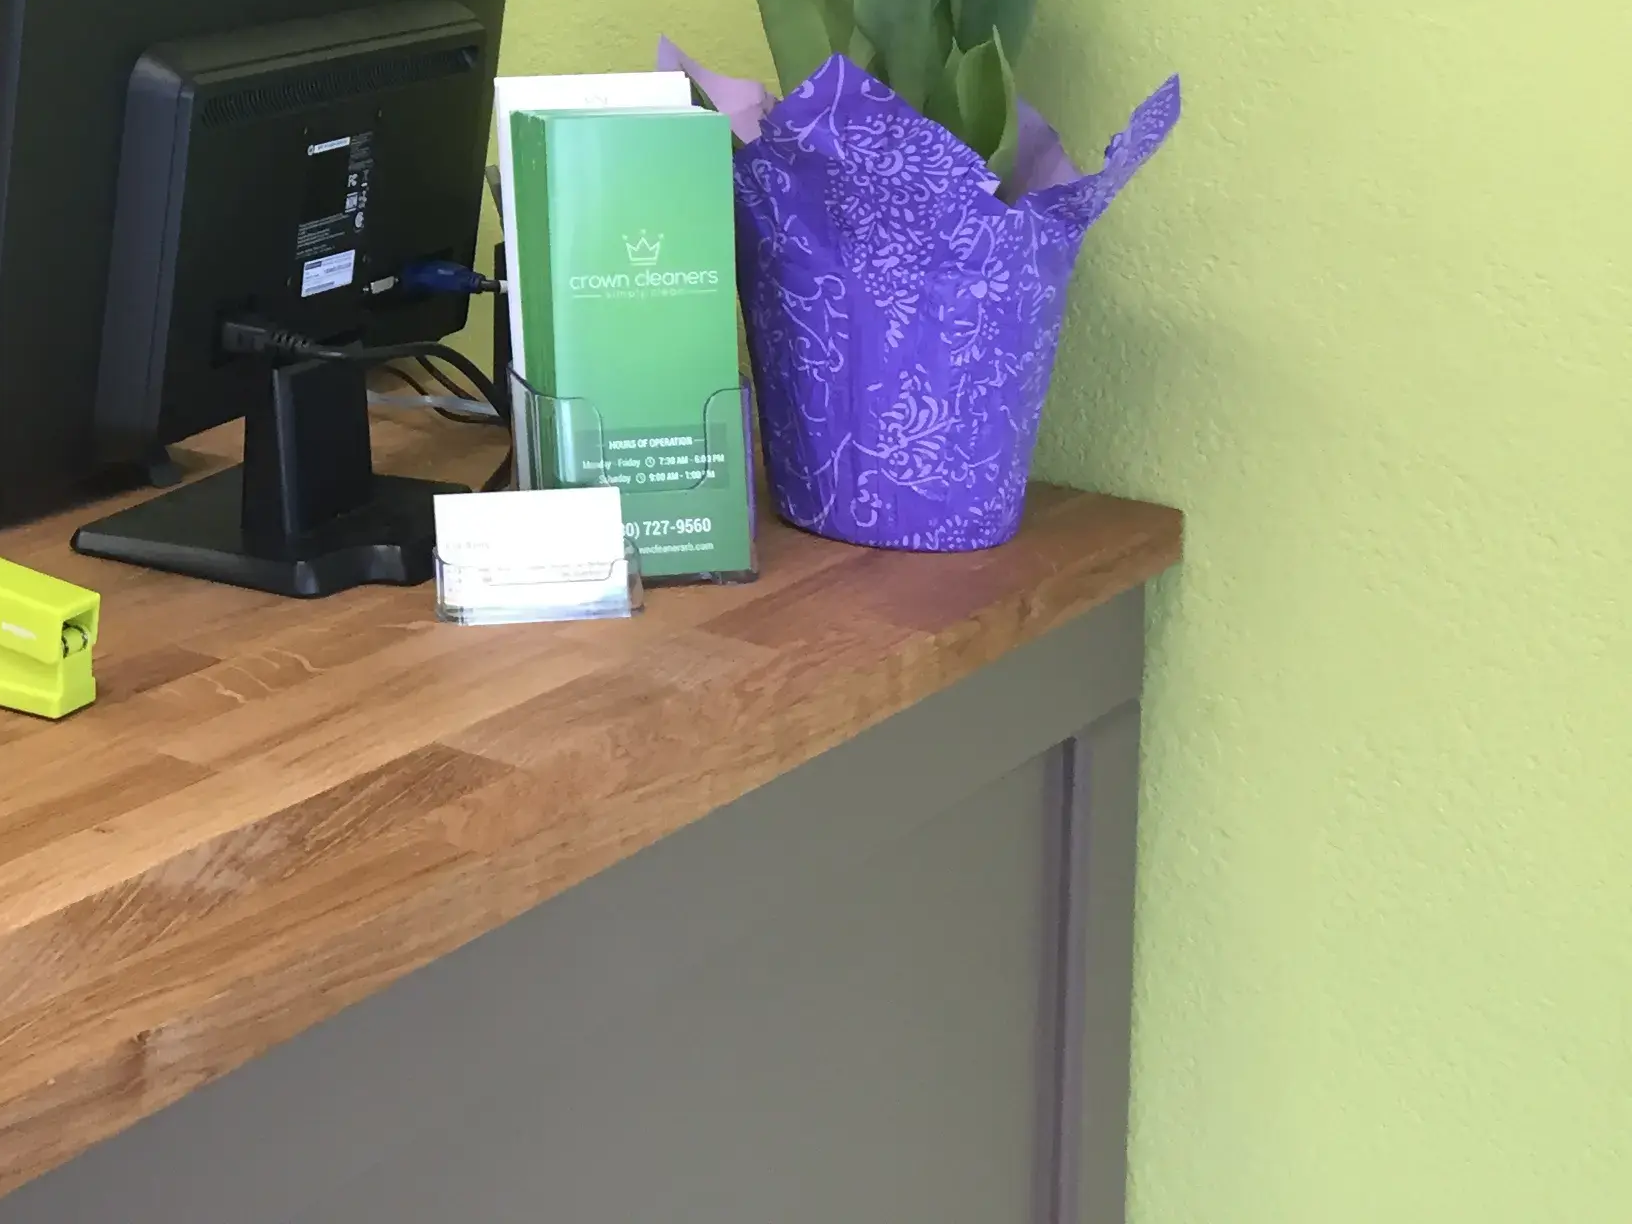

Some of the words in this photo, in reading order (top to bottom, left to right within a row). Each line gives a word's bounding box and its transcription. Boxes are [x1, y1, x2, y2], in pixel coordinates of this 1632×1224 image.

[569, 273, 630, 290] crown
[634, 269, 719, 287] cleaners
[608, 440, 637, 450] HOURS
[637, 438, 648, 448] OF
[649, 436, 693, 447] OPERATION
[617, 458, 641, 468] Friday
[658, 456, 676, 466] 7:30
[676, 456, 689, 464] AM
[712, 453, 725, 462] PM
[666, 471, 679, 480] AM
[643, 517, 712, 536] 727-9560
